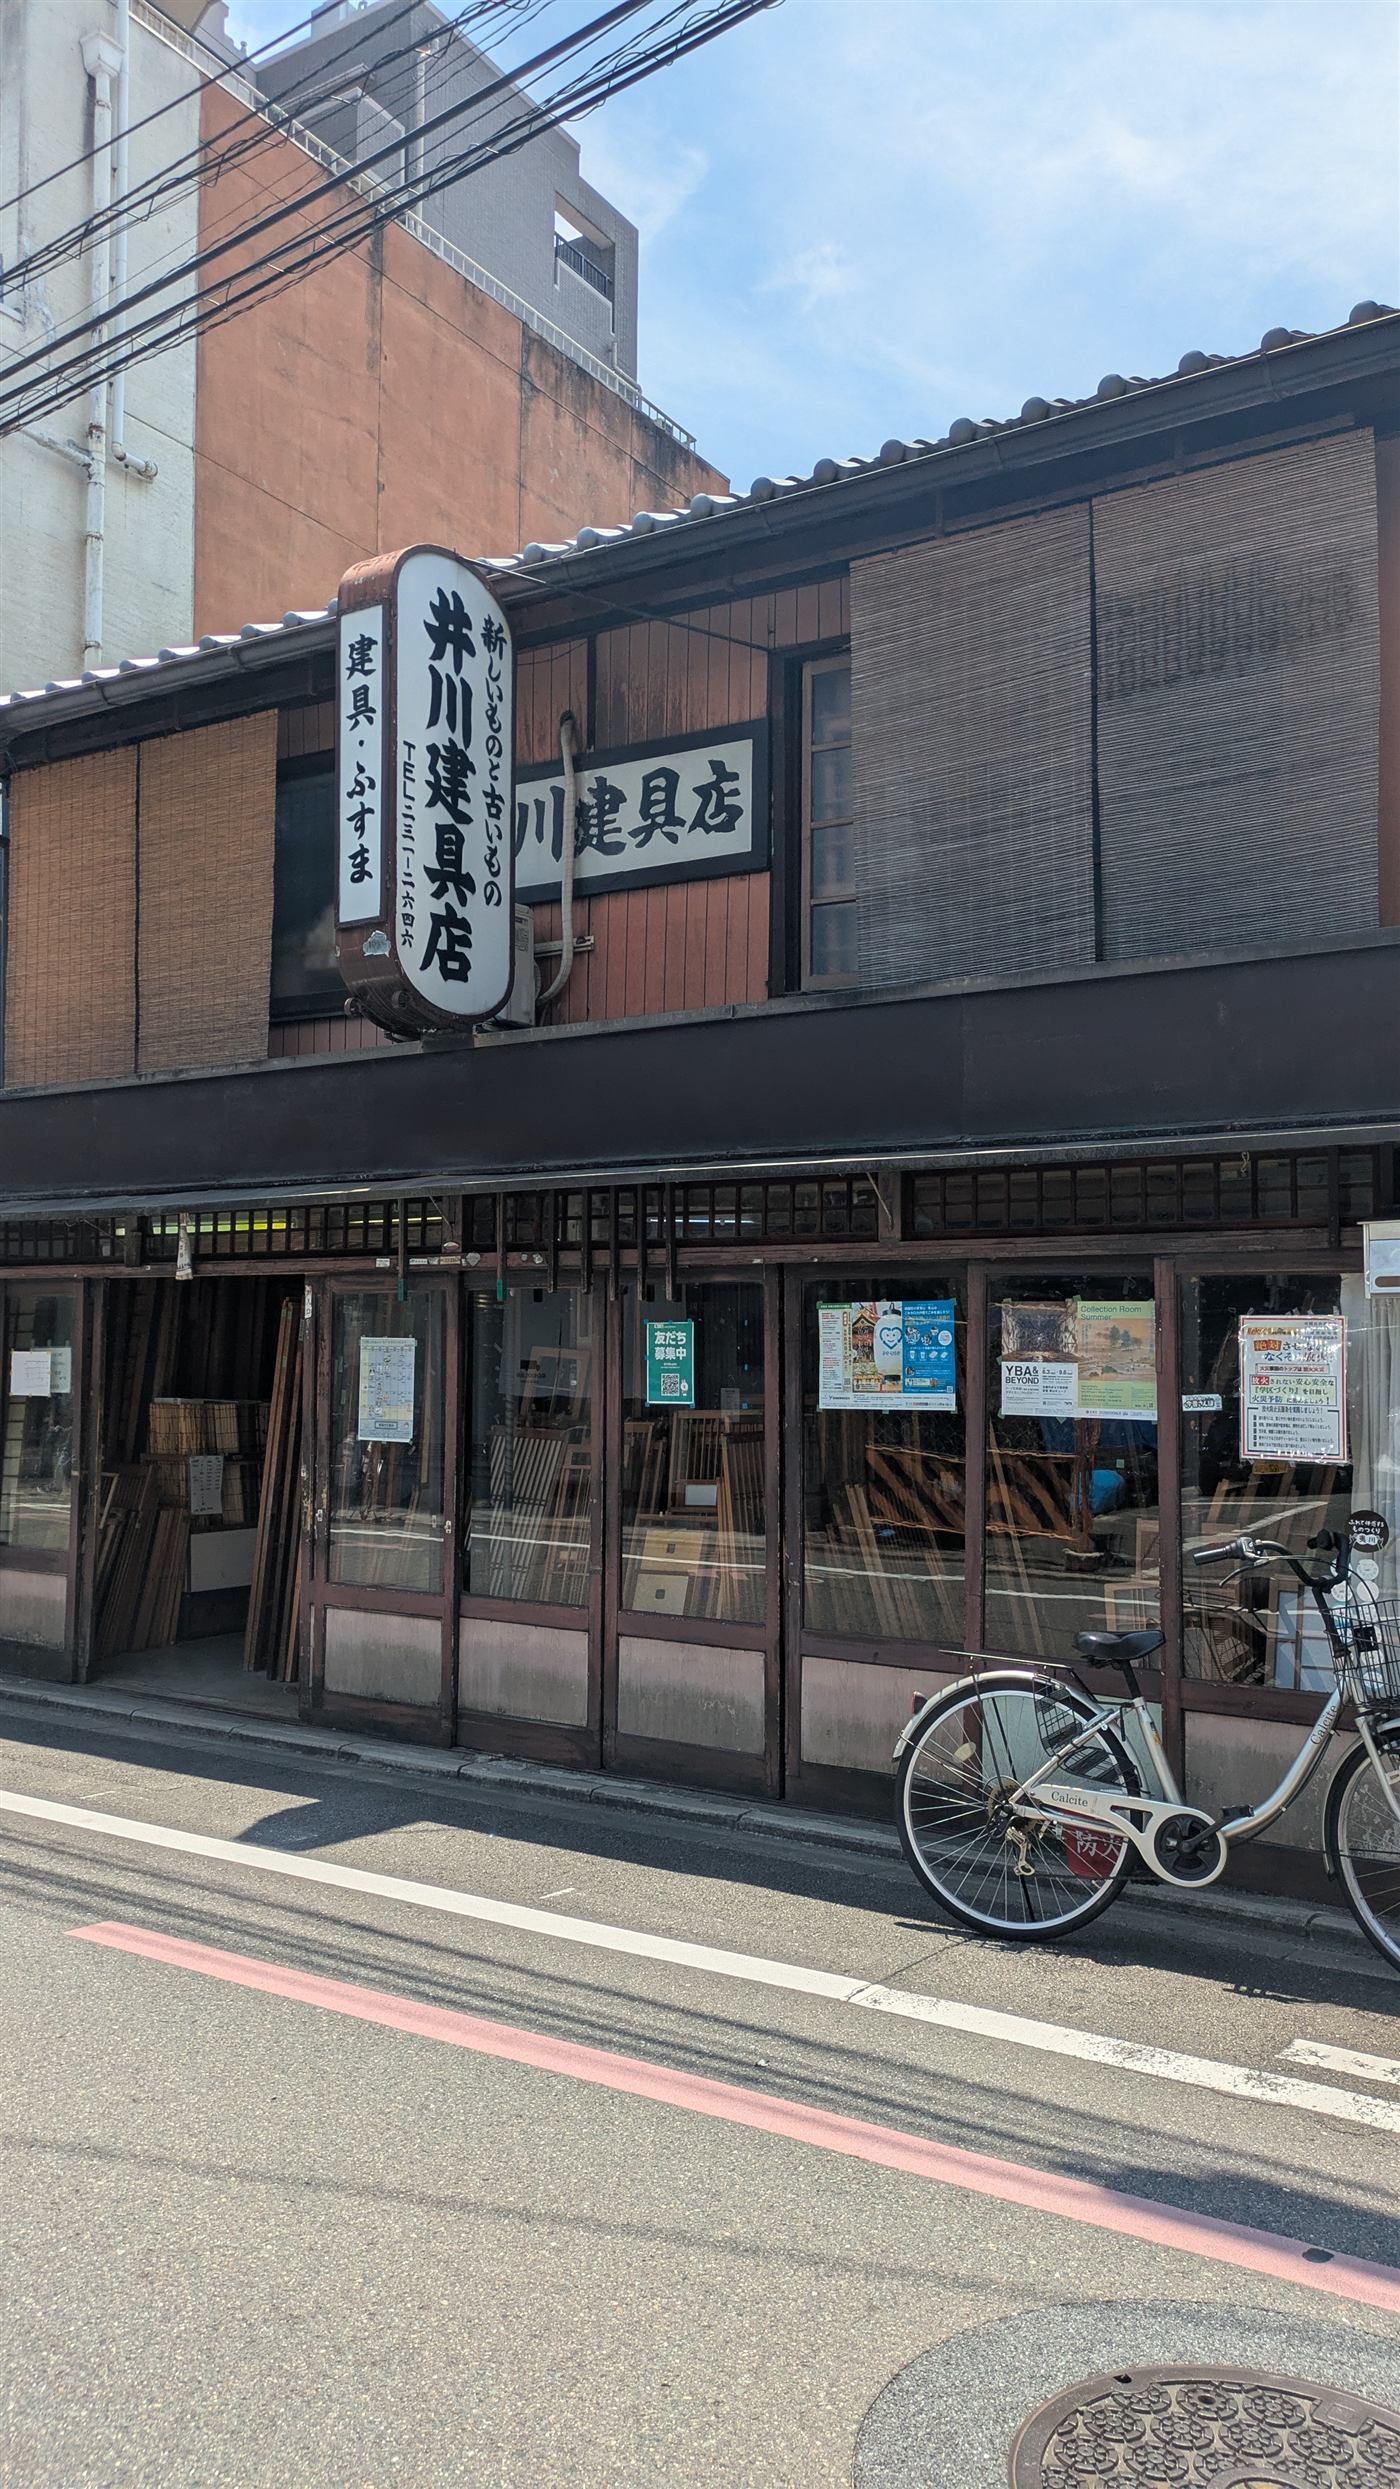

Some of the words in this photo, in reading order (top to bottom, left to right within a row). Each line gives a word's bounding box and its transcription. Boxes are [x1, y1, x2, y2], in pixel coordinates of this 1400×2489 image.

[345, 633, 379, 884] 建具・ふすま
[480, 613, 507, 907] 新しいものと古いもの
[419, 586, 477, 982] 井川建具店
[1081, 1305, 1118, 1313] Collection
[1119, 1305, 1142, 1313] Room
[1081, 1313, 1112, 1321] Summer
[654, 1331, 687, 1345] 友だち
[654, 1346, 687, 1360] 募集中
[1005, 1376, 1040, 1386] BEYOND
[1310, 1705, 1338, 1745] Calcite
[1051, 1791, 1088, 1807] Calcite
